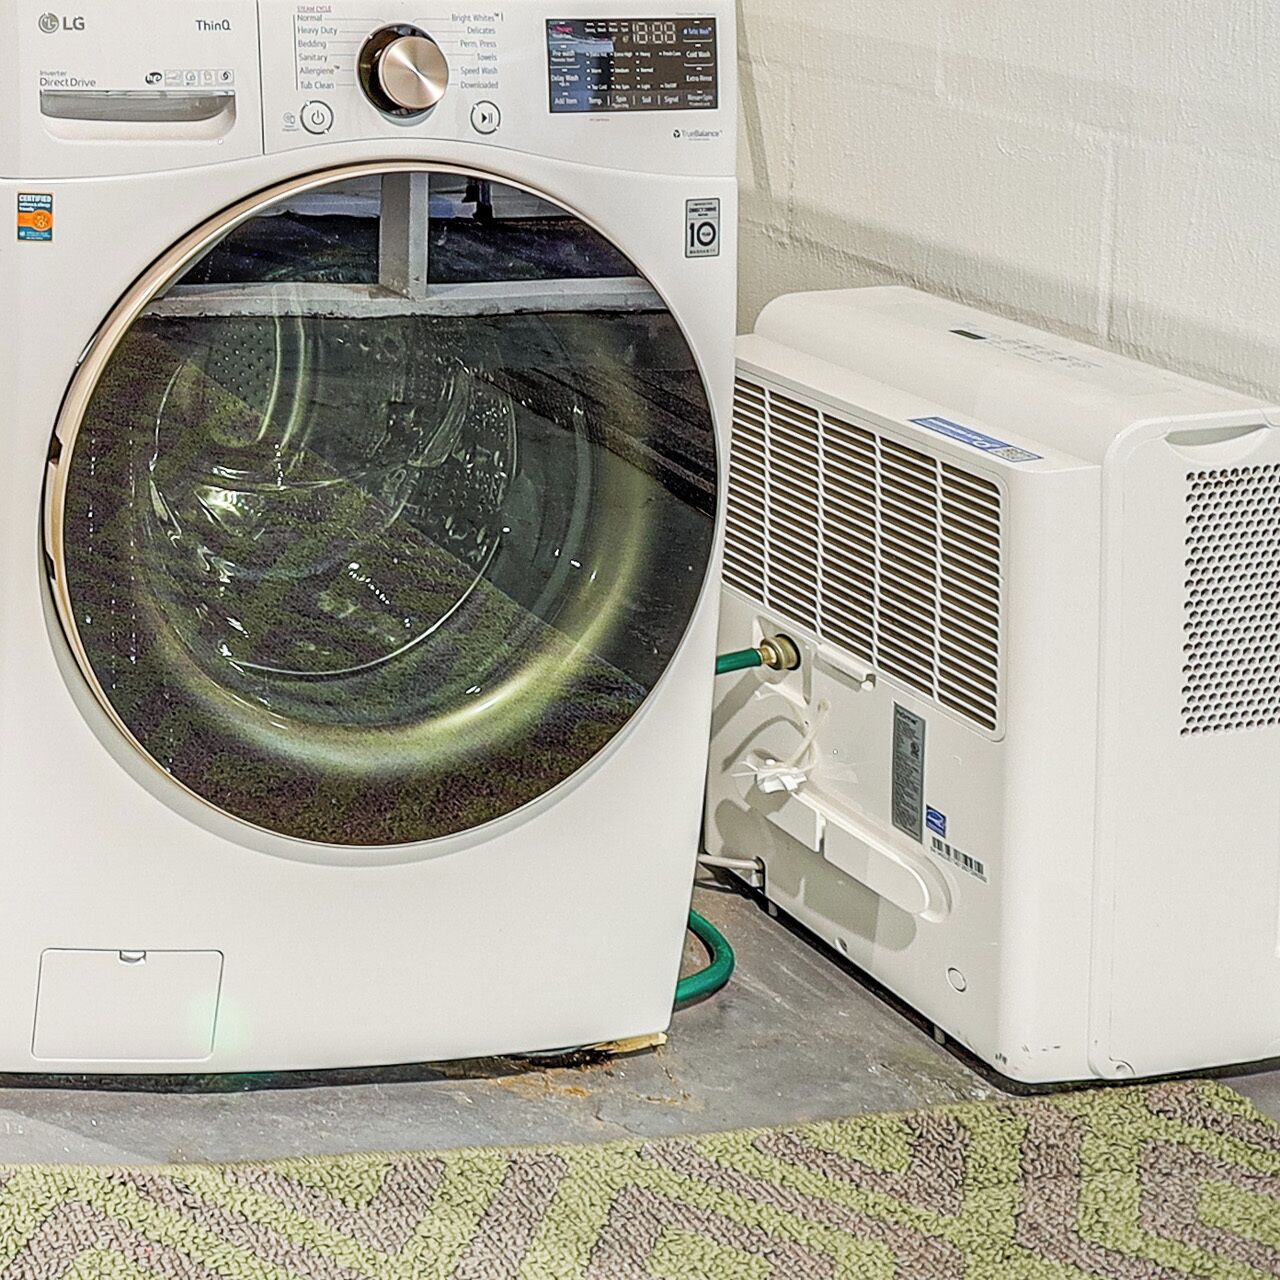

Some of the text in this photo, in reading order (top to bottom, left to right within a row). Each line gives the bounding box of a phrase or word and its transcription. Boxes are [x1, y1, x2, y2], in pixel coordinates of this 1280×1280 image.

[297, 14, 322, 22] Normal
[452, 13, 472, 23] Bright
[63, 16, 85, 30] LG
[195, 19, 232, 31] ThinQ
[298, 26, 338, 36] Heavy Duty
[467, 26, 496, 34] Delicates
[298, 40, 326, 50] Bedding
[480, 40, 496, 48] Press
[299, 52, 328, 62] Sanitary
[477, 52, 498, 60] Towels
[460, 66, 498, 76] Speed Wash
[552, 74, 564, 82] Delay
[686, 74, 699, 82] Extra
[301, 81, 334, 89] Tub Clean
[664, 96, 679, 104] Signal
[19, 194, 52, 202] CERTIFIED
[690, 222, 716, 248] 10
